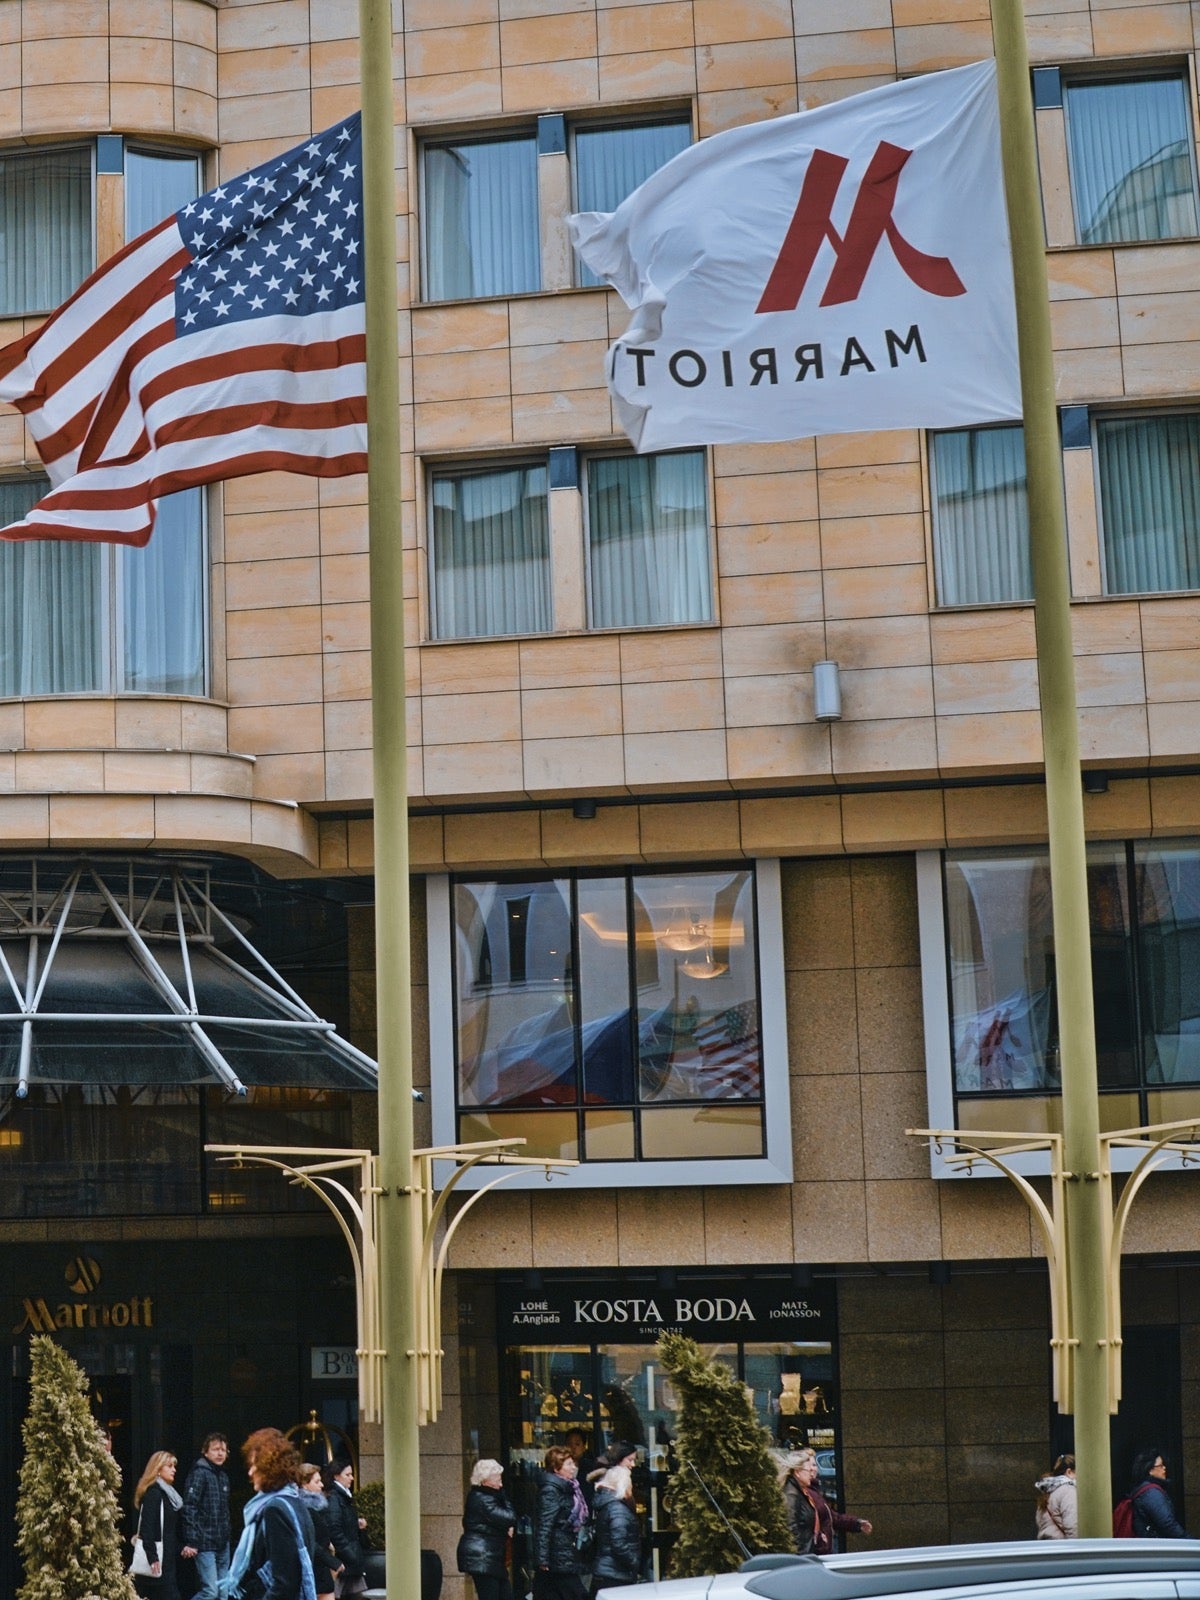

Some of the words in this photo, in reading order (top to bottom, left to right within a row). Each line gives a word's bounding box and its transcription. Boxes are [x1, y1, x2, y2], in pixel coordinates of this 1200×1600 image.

[574, 1299, 664, 1323] KOSTA
[675, 1298, 756, 1322] BODA
[781, 1301, 808, 1310] MATS
[12, 1296, 154, 1334] Marriott
[512, 1314, 560, 1325] A.Anglada
[769, 1309, 821, 1319] JONASSON
